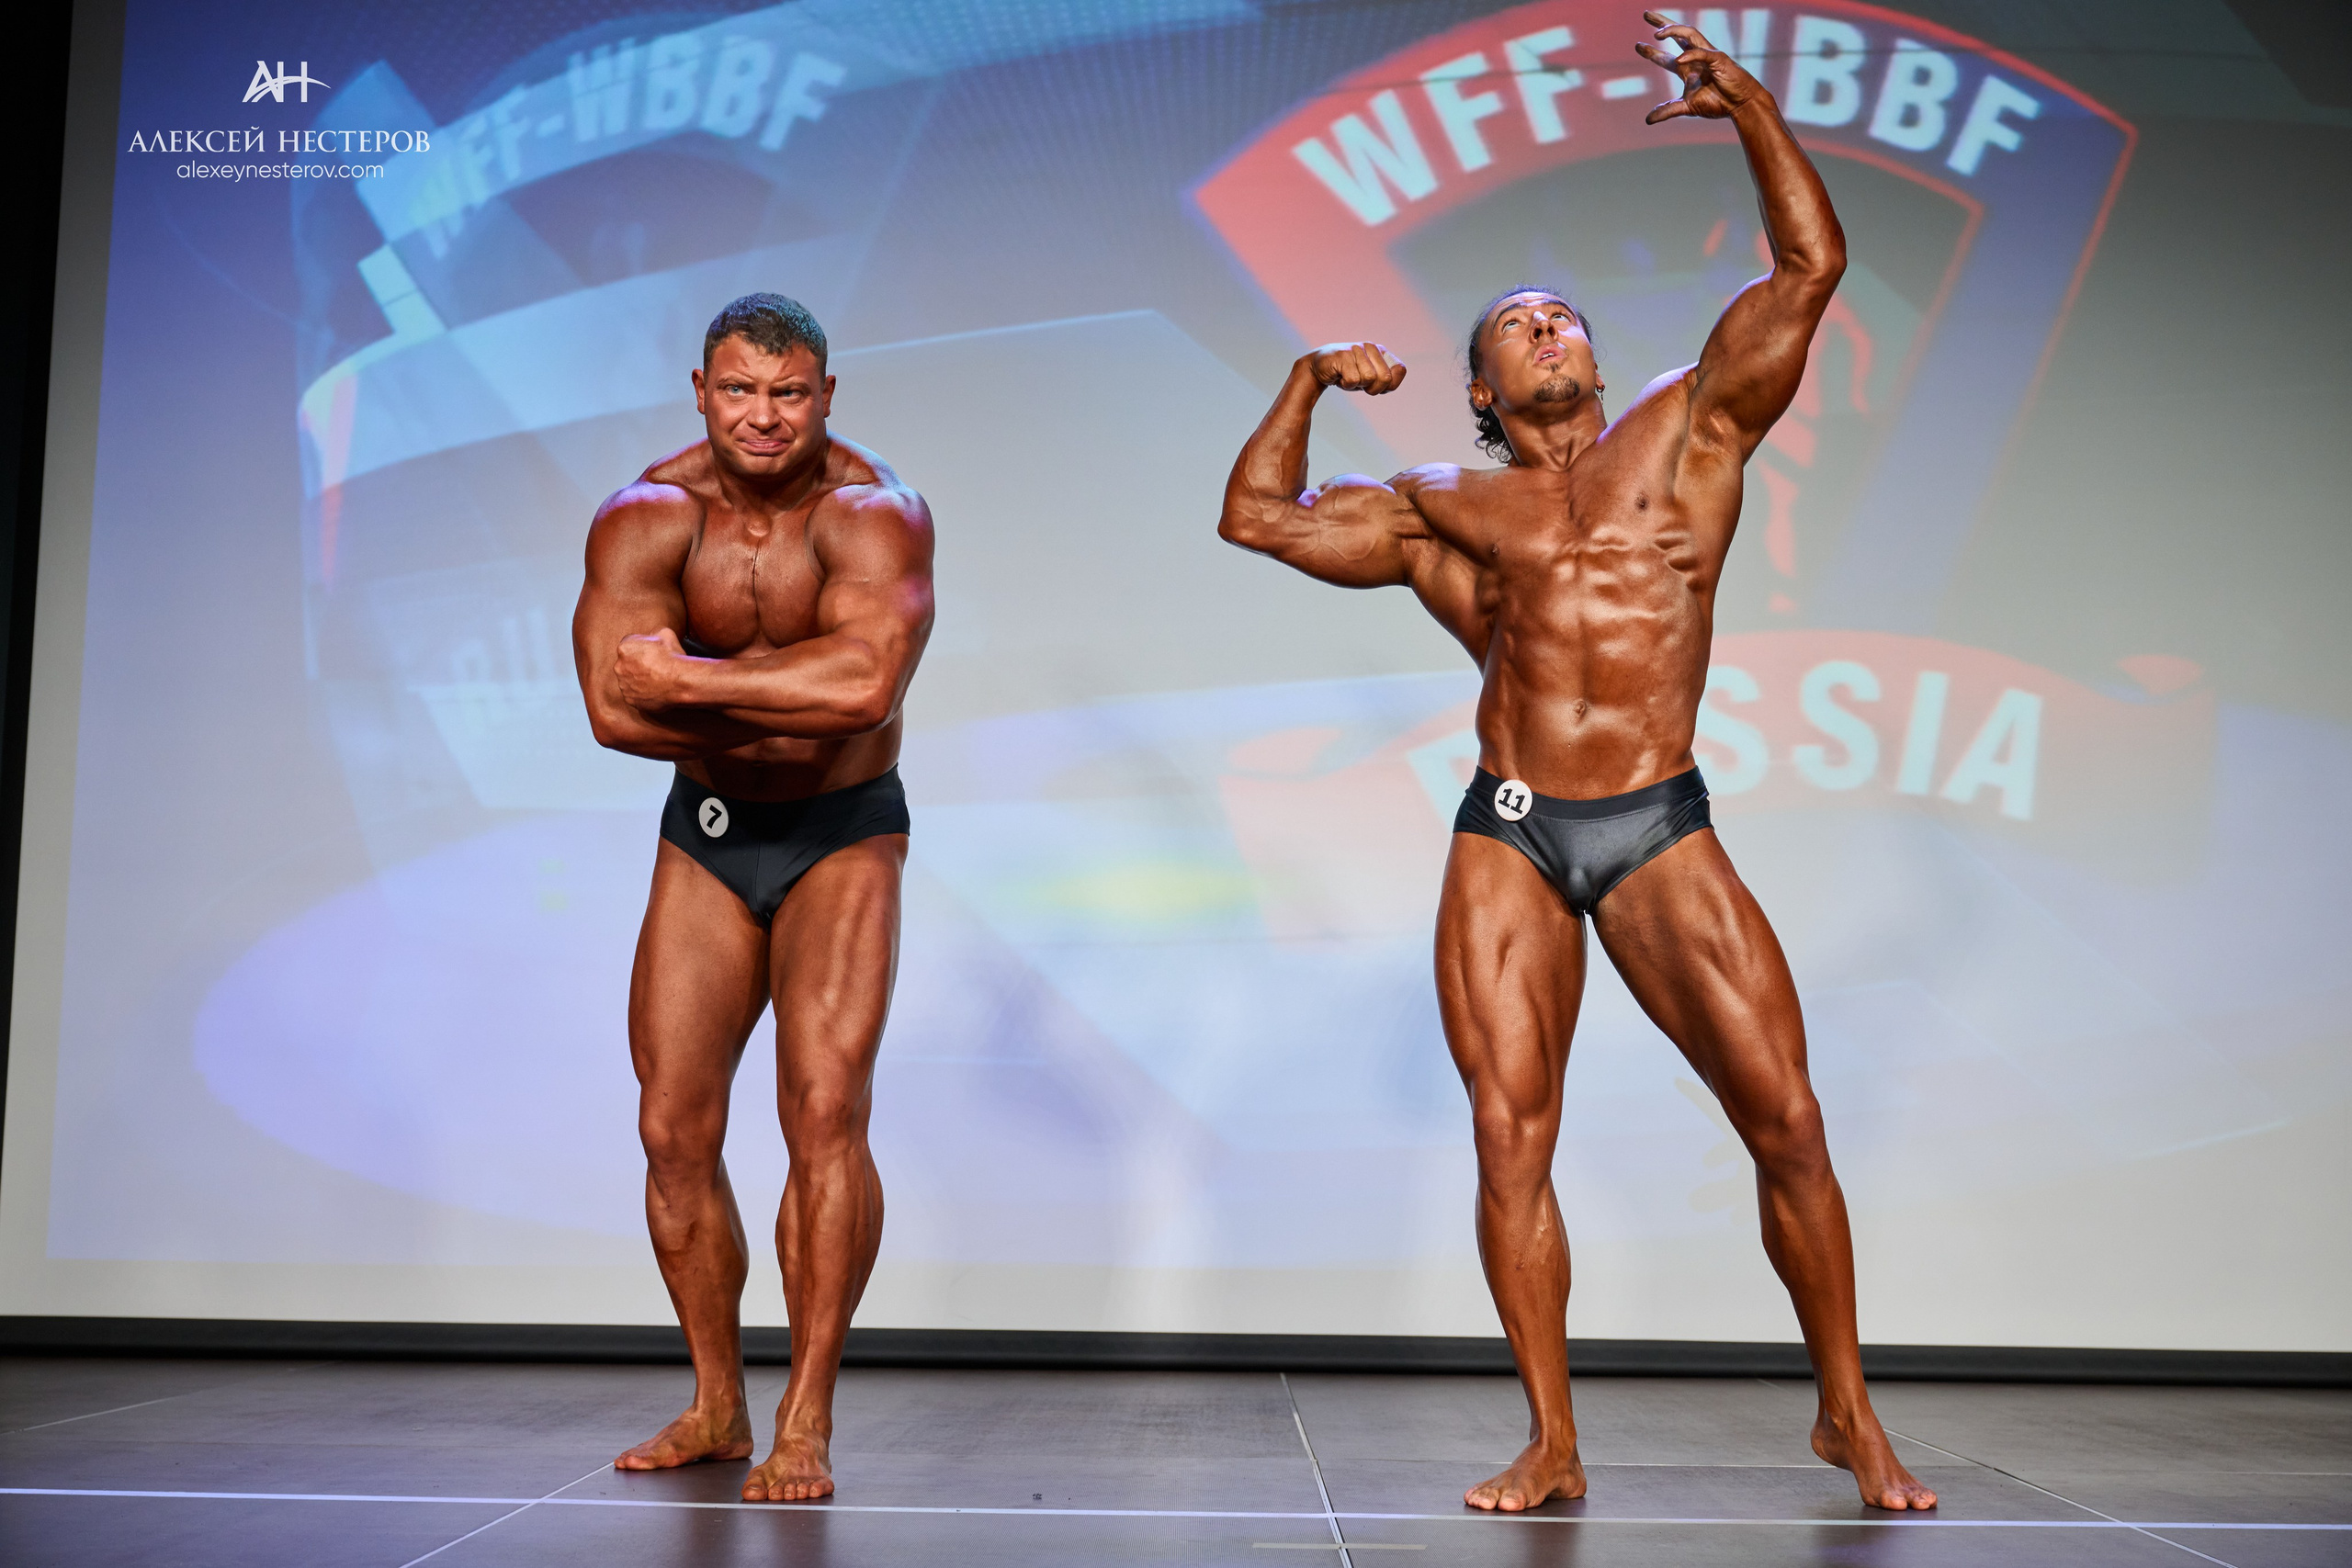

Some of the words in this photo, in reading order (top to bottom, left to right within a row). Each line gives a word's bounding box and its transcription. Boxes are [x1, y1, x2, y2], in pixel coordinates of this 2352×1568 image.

[1405, 660, 2044, 831] SSIA
[1498, 788, 1526, 815] 11
[707, 804, 723, 829] 7
